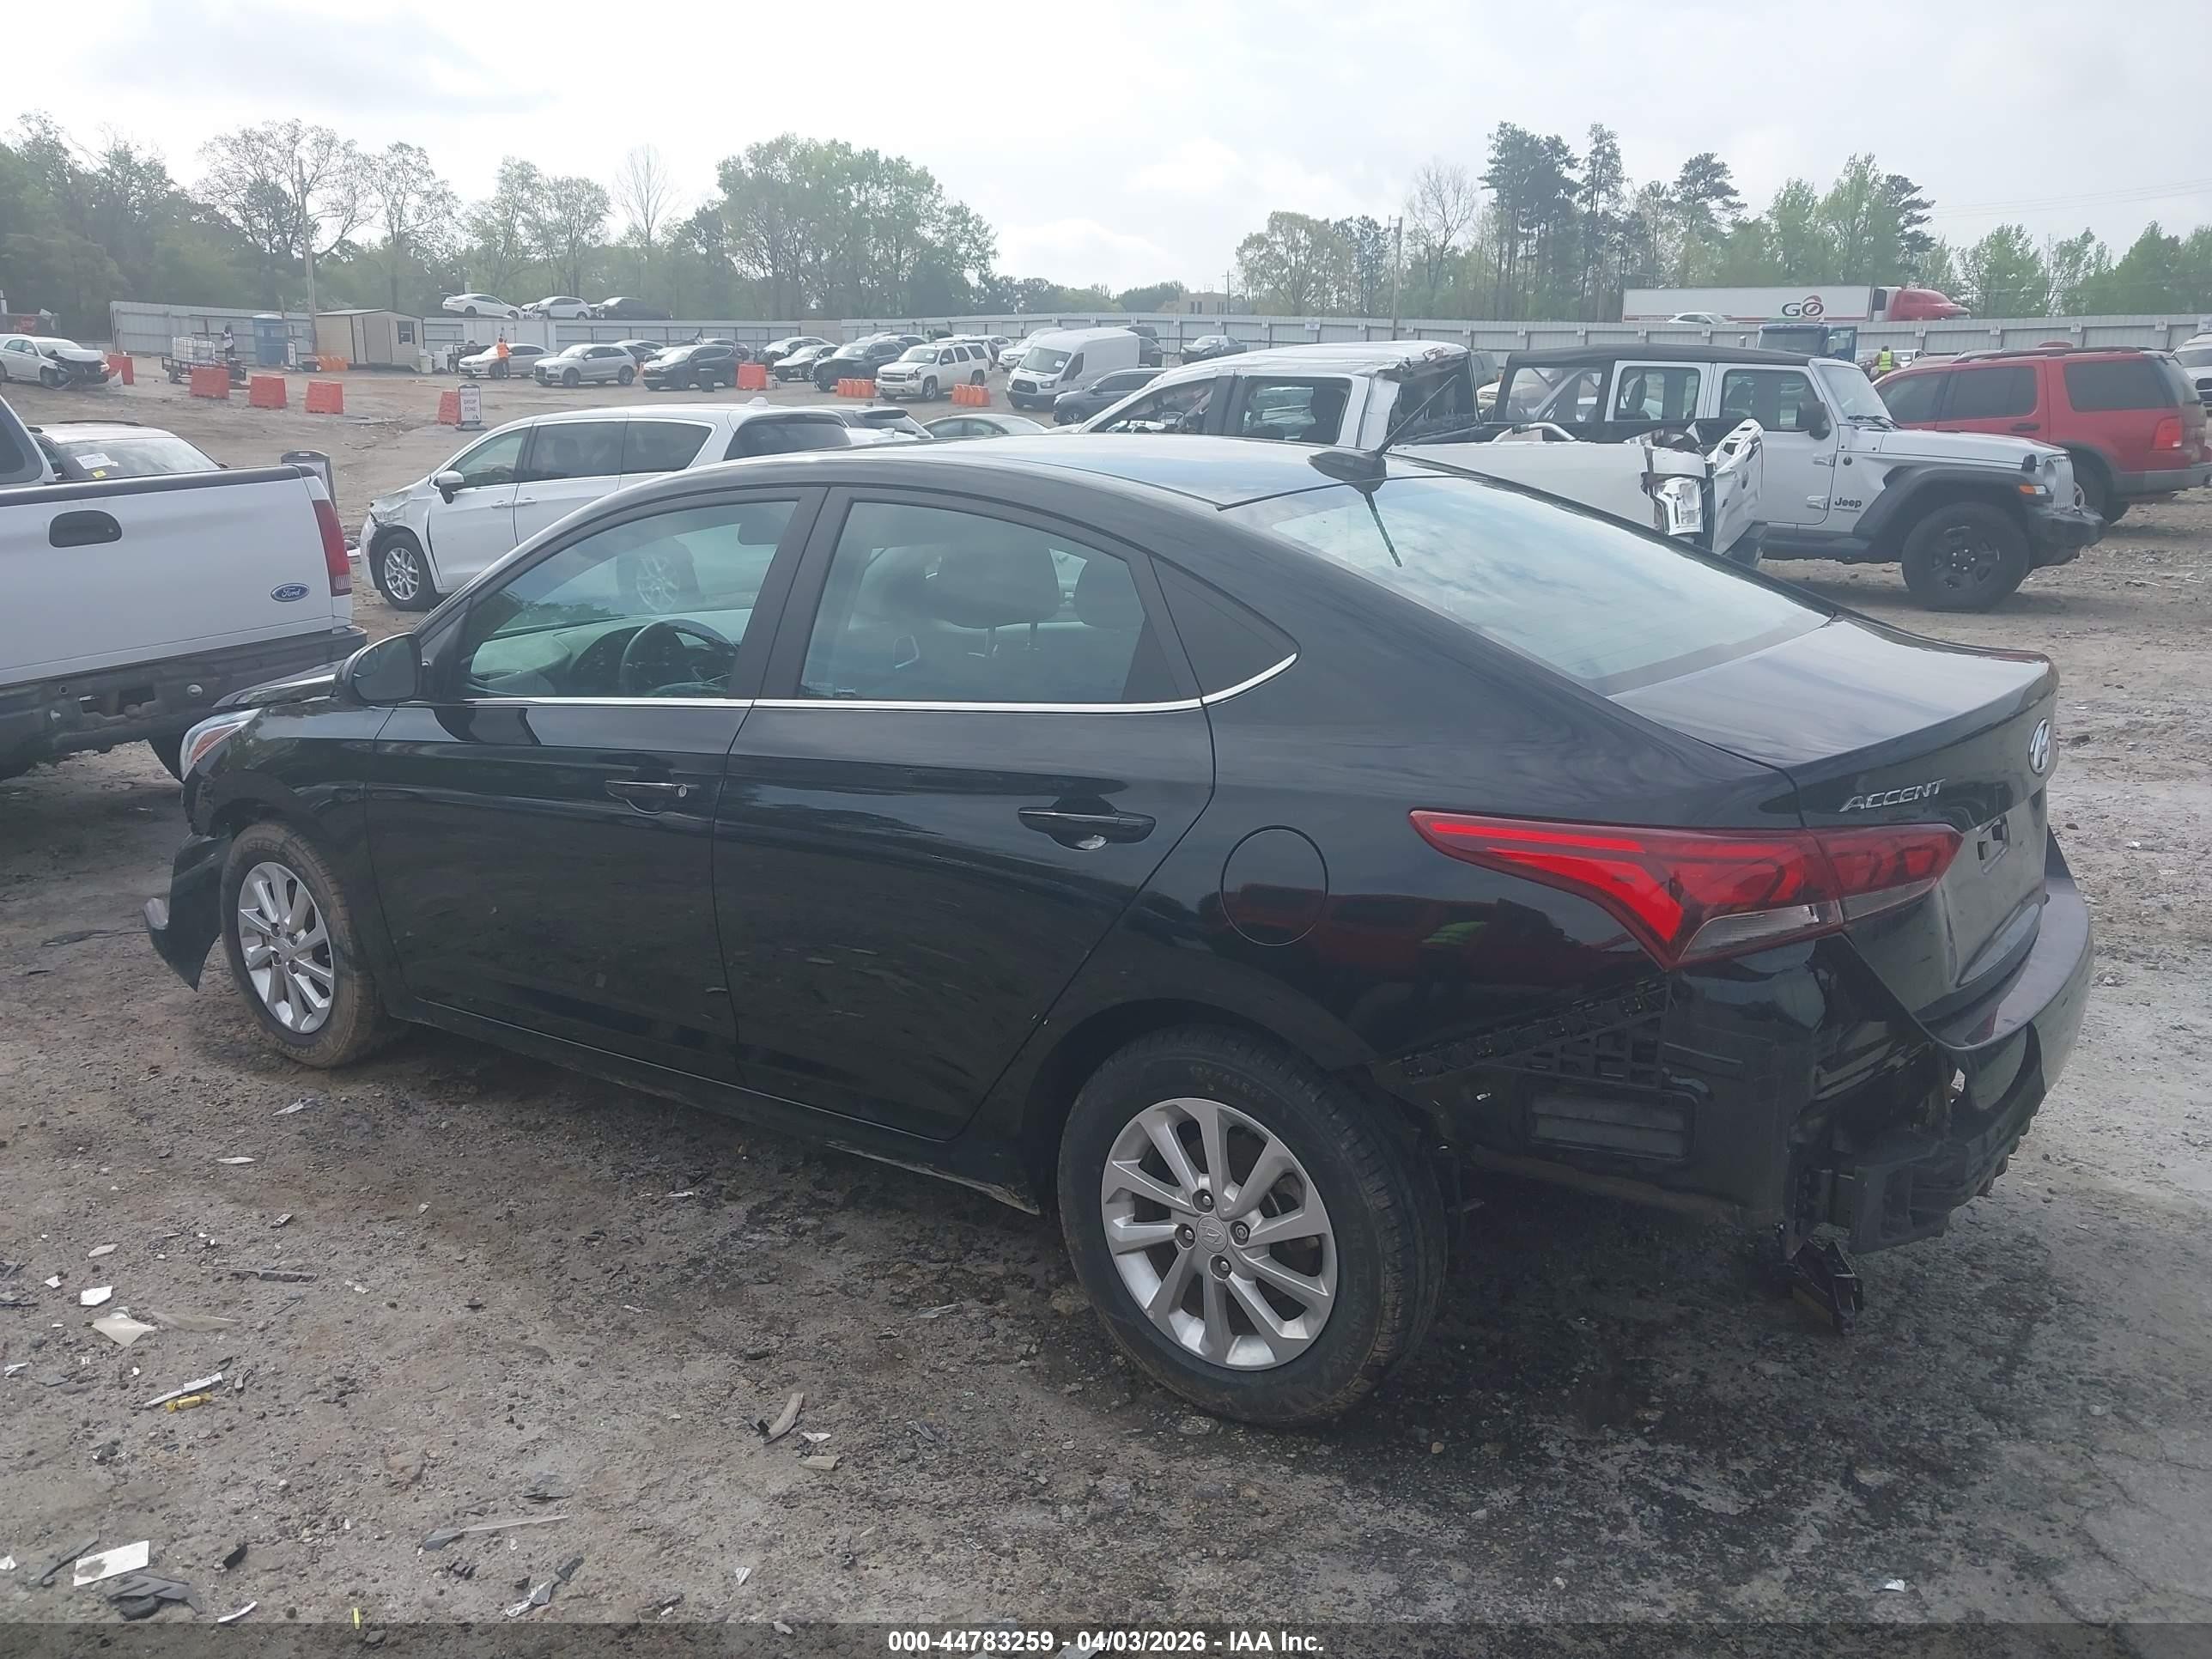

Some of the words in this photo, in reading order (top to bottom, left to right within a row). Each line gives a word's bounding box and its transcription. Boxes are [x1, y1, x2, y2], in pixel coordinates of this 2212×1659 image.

[1781, 301, 1825, 317] GO
[1834, 497, 1863, 508] Jeep
[1838, 778, 1947, 812] ACCENT
